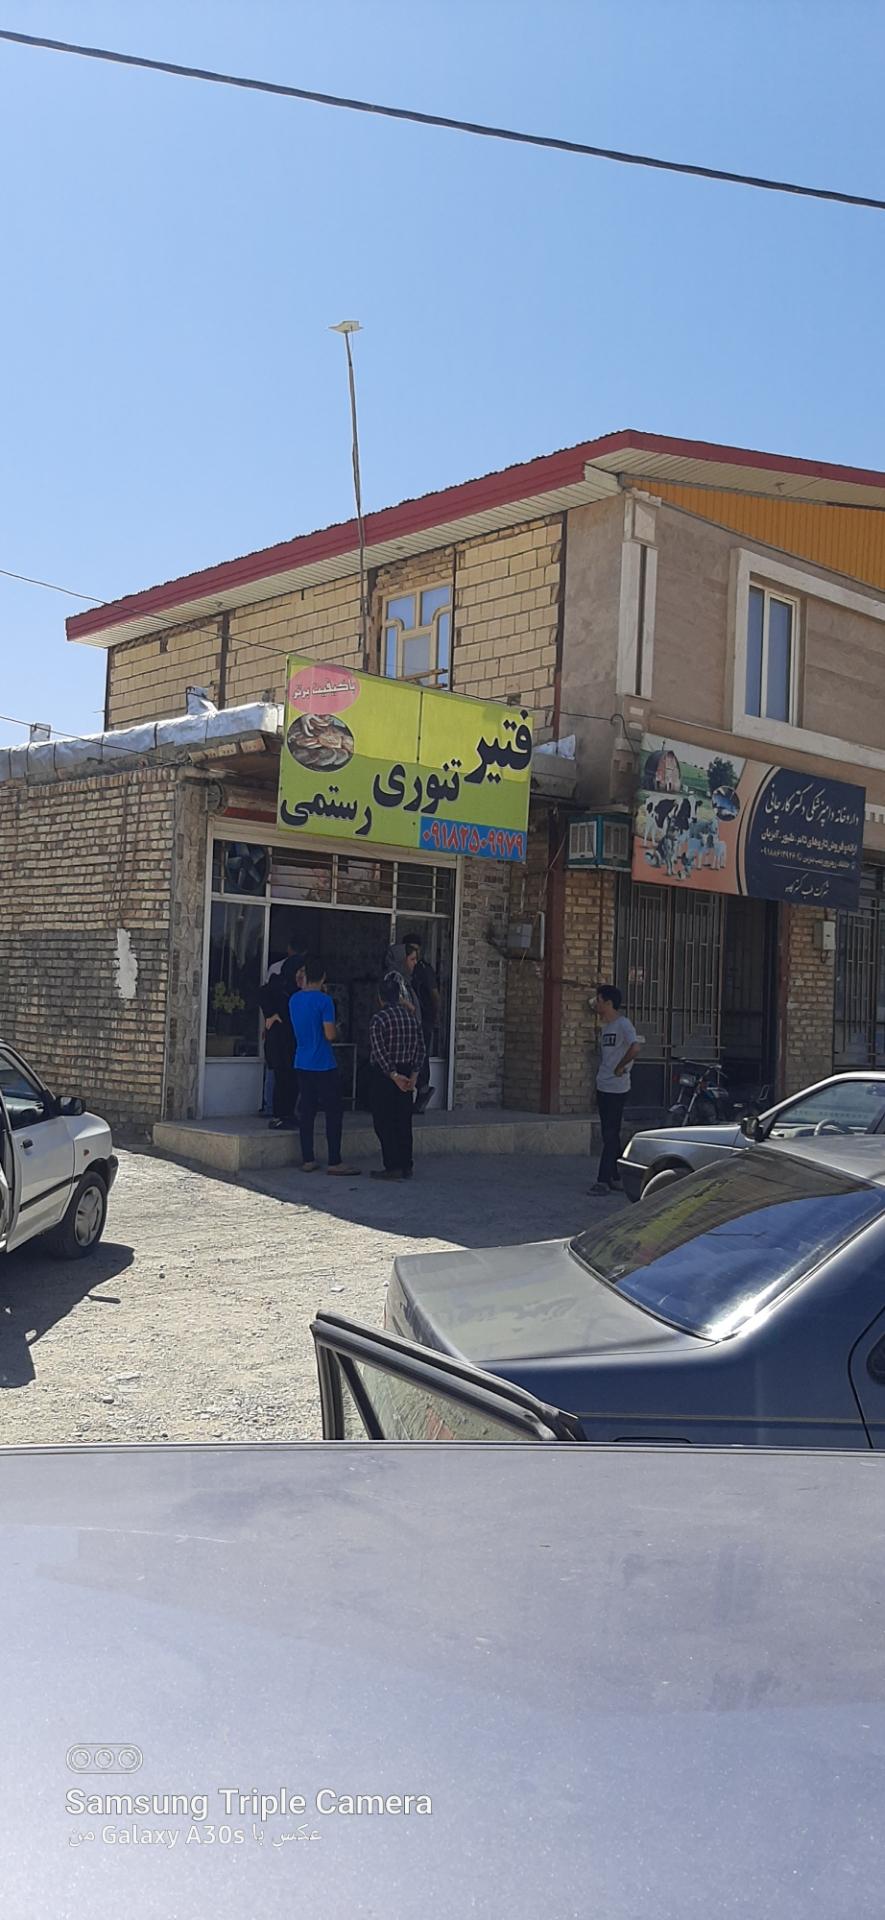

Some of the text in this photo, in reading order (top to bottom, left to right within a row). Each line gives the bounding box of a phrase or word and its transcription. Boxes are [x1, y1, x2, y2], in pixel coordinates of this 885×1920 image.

[280, 709, 533, 836] فتیر تنوری رستمی
[806, 788, 834, 827] دامپزشکی
[834, 807, 858, 826] داروخانه
